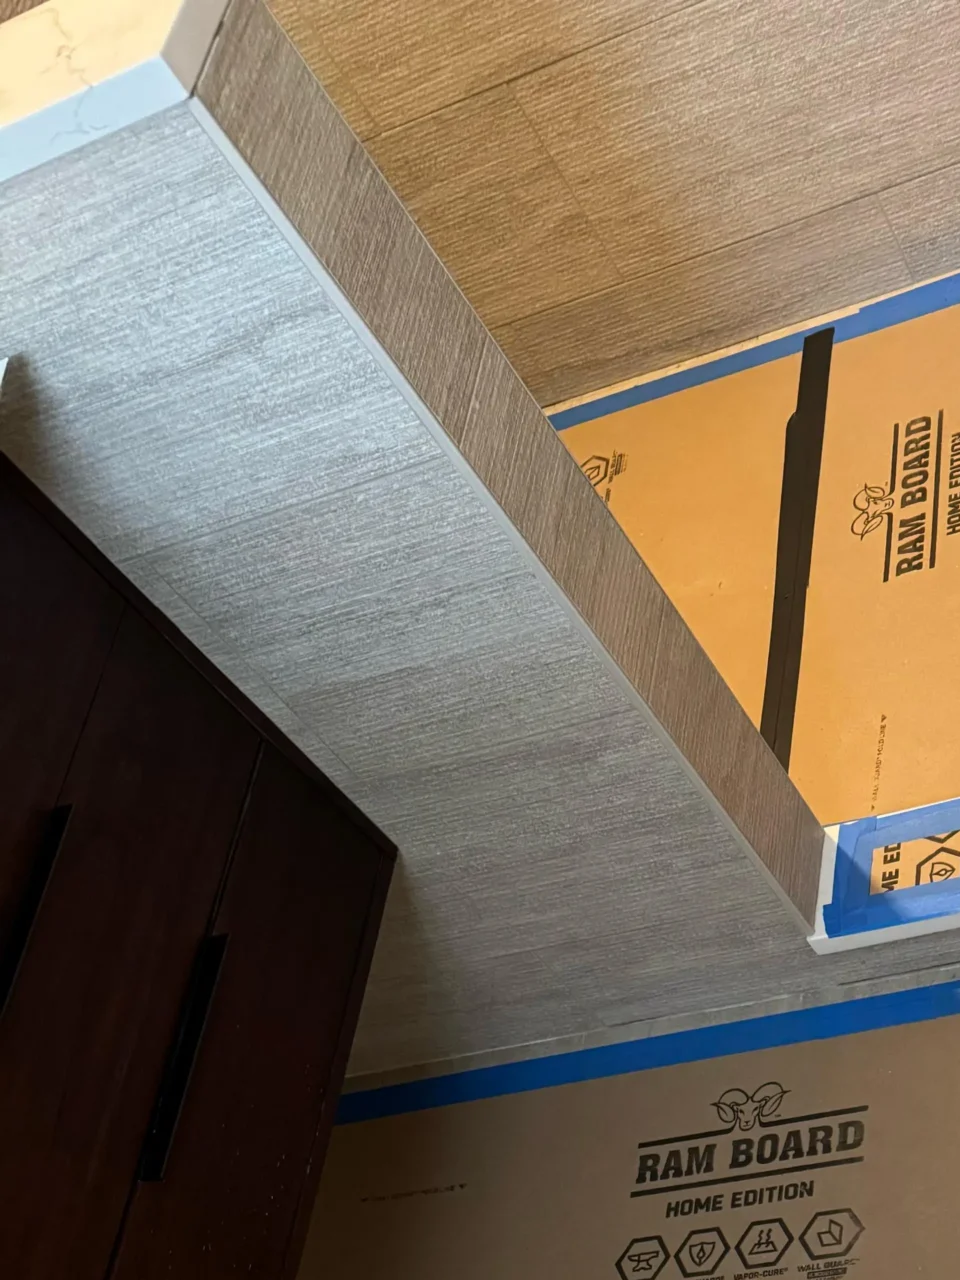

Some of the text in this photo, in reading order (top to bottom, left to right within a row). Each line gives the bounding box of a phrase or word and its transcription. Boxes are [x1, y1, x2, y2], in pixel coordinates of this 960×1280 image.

[896, 416, 931, 577] RAM BOARD
[635, 1120, 865, 1184] RAM BOARD
[666, 1180, 814, 1218] HOME EDITION
[797, 1263, 821, 1272] WALL
